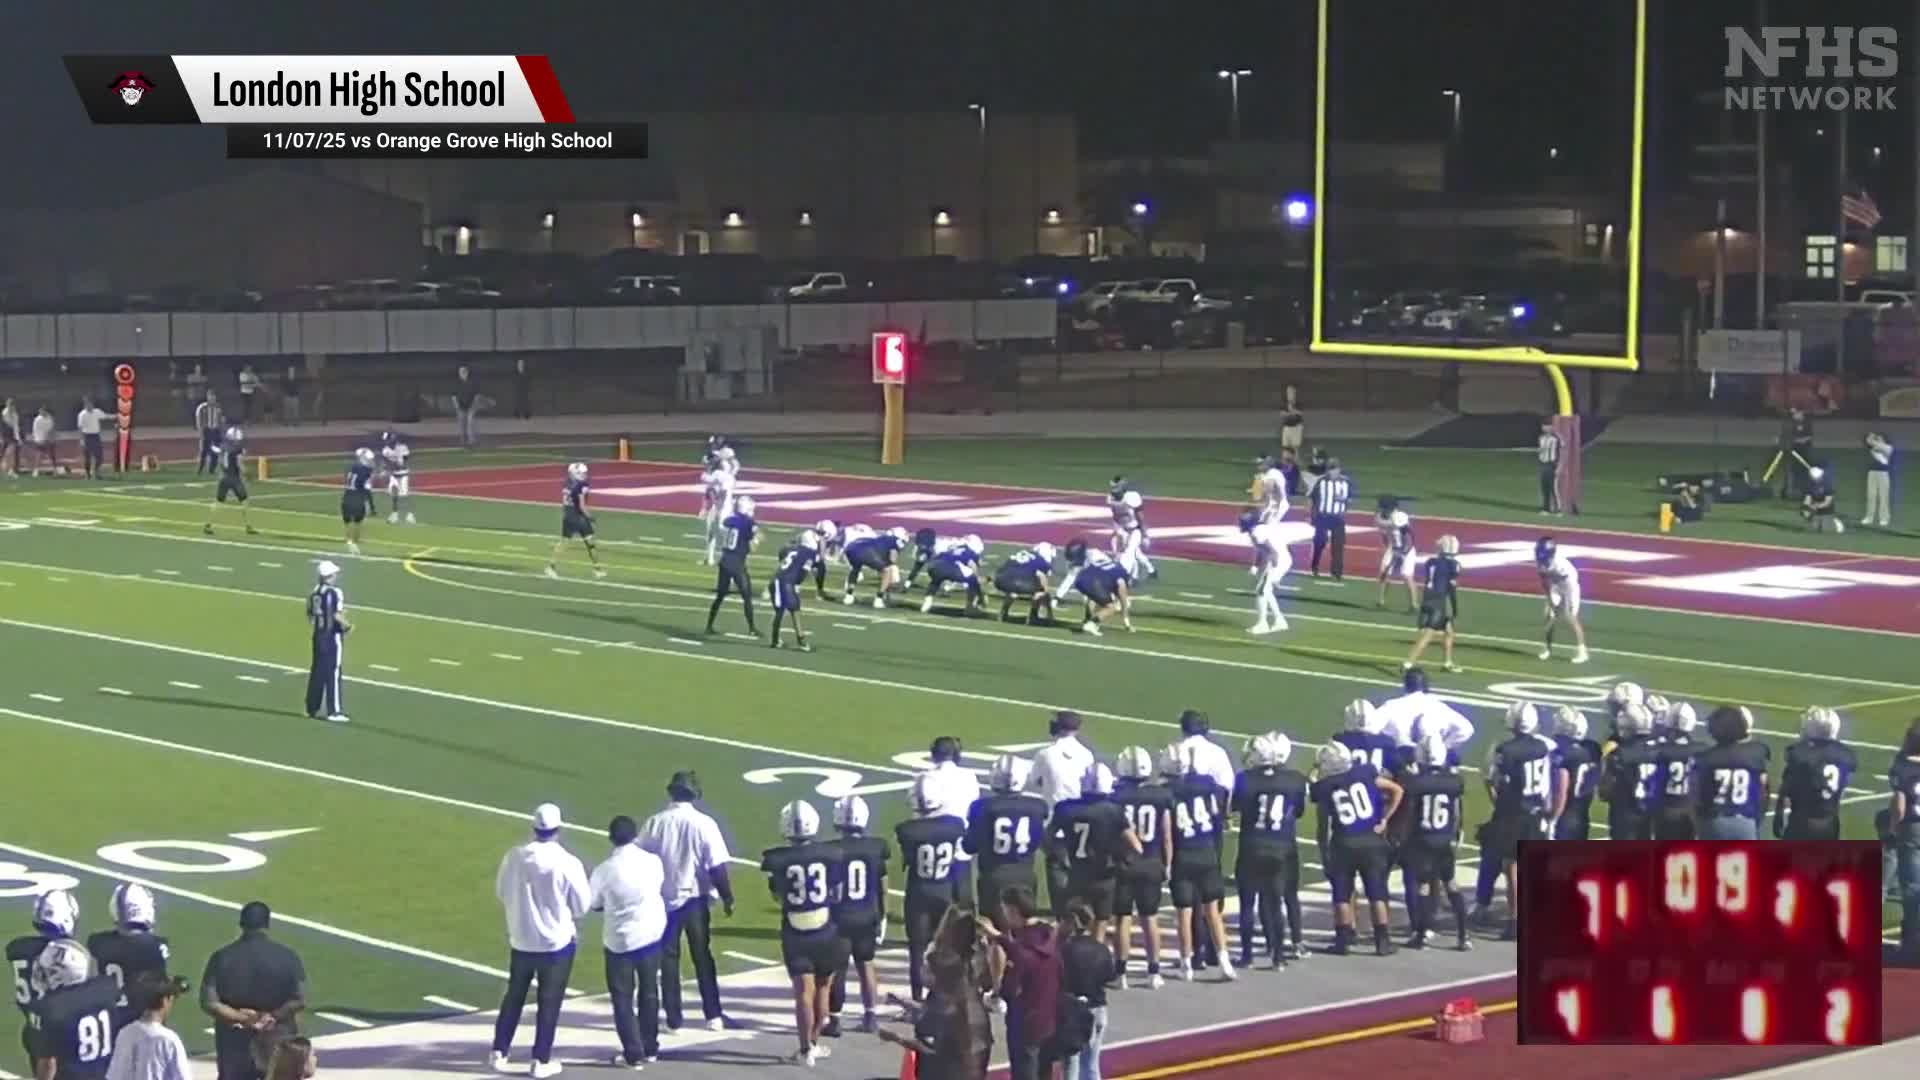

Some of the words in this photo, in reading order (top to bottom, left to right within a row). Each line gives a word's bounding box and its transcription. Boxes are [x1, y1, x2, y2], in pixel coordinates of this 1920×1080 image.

[1713, 768, 1750, 805] 78
[1822, 763, 1840, 800] 3
[1176, 796, 1213, 838] 44
[1256, 793, 1285, 831] 14
[1423, 794, 1449, 830] 16
[993, 816, 1032, 854] 64
[1074, 823, 1090, 859] 7
[917, 842, 953, 880] 82
[787, 862, 828, 905] 33
[78, 1009, 112, 1062] 81
